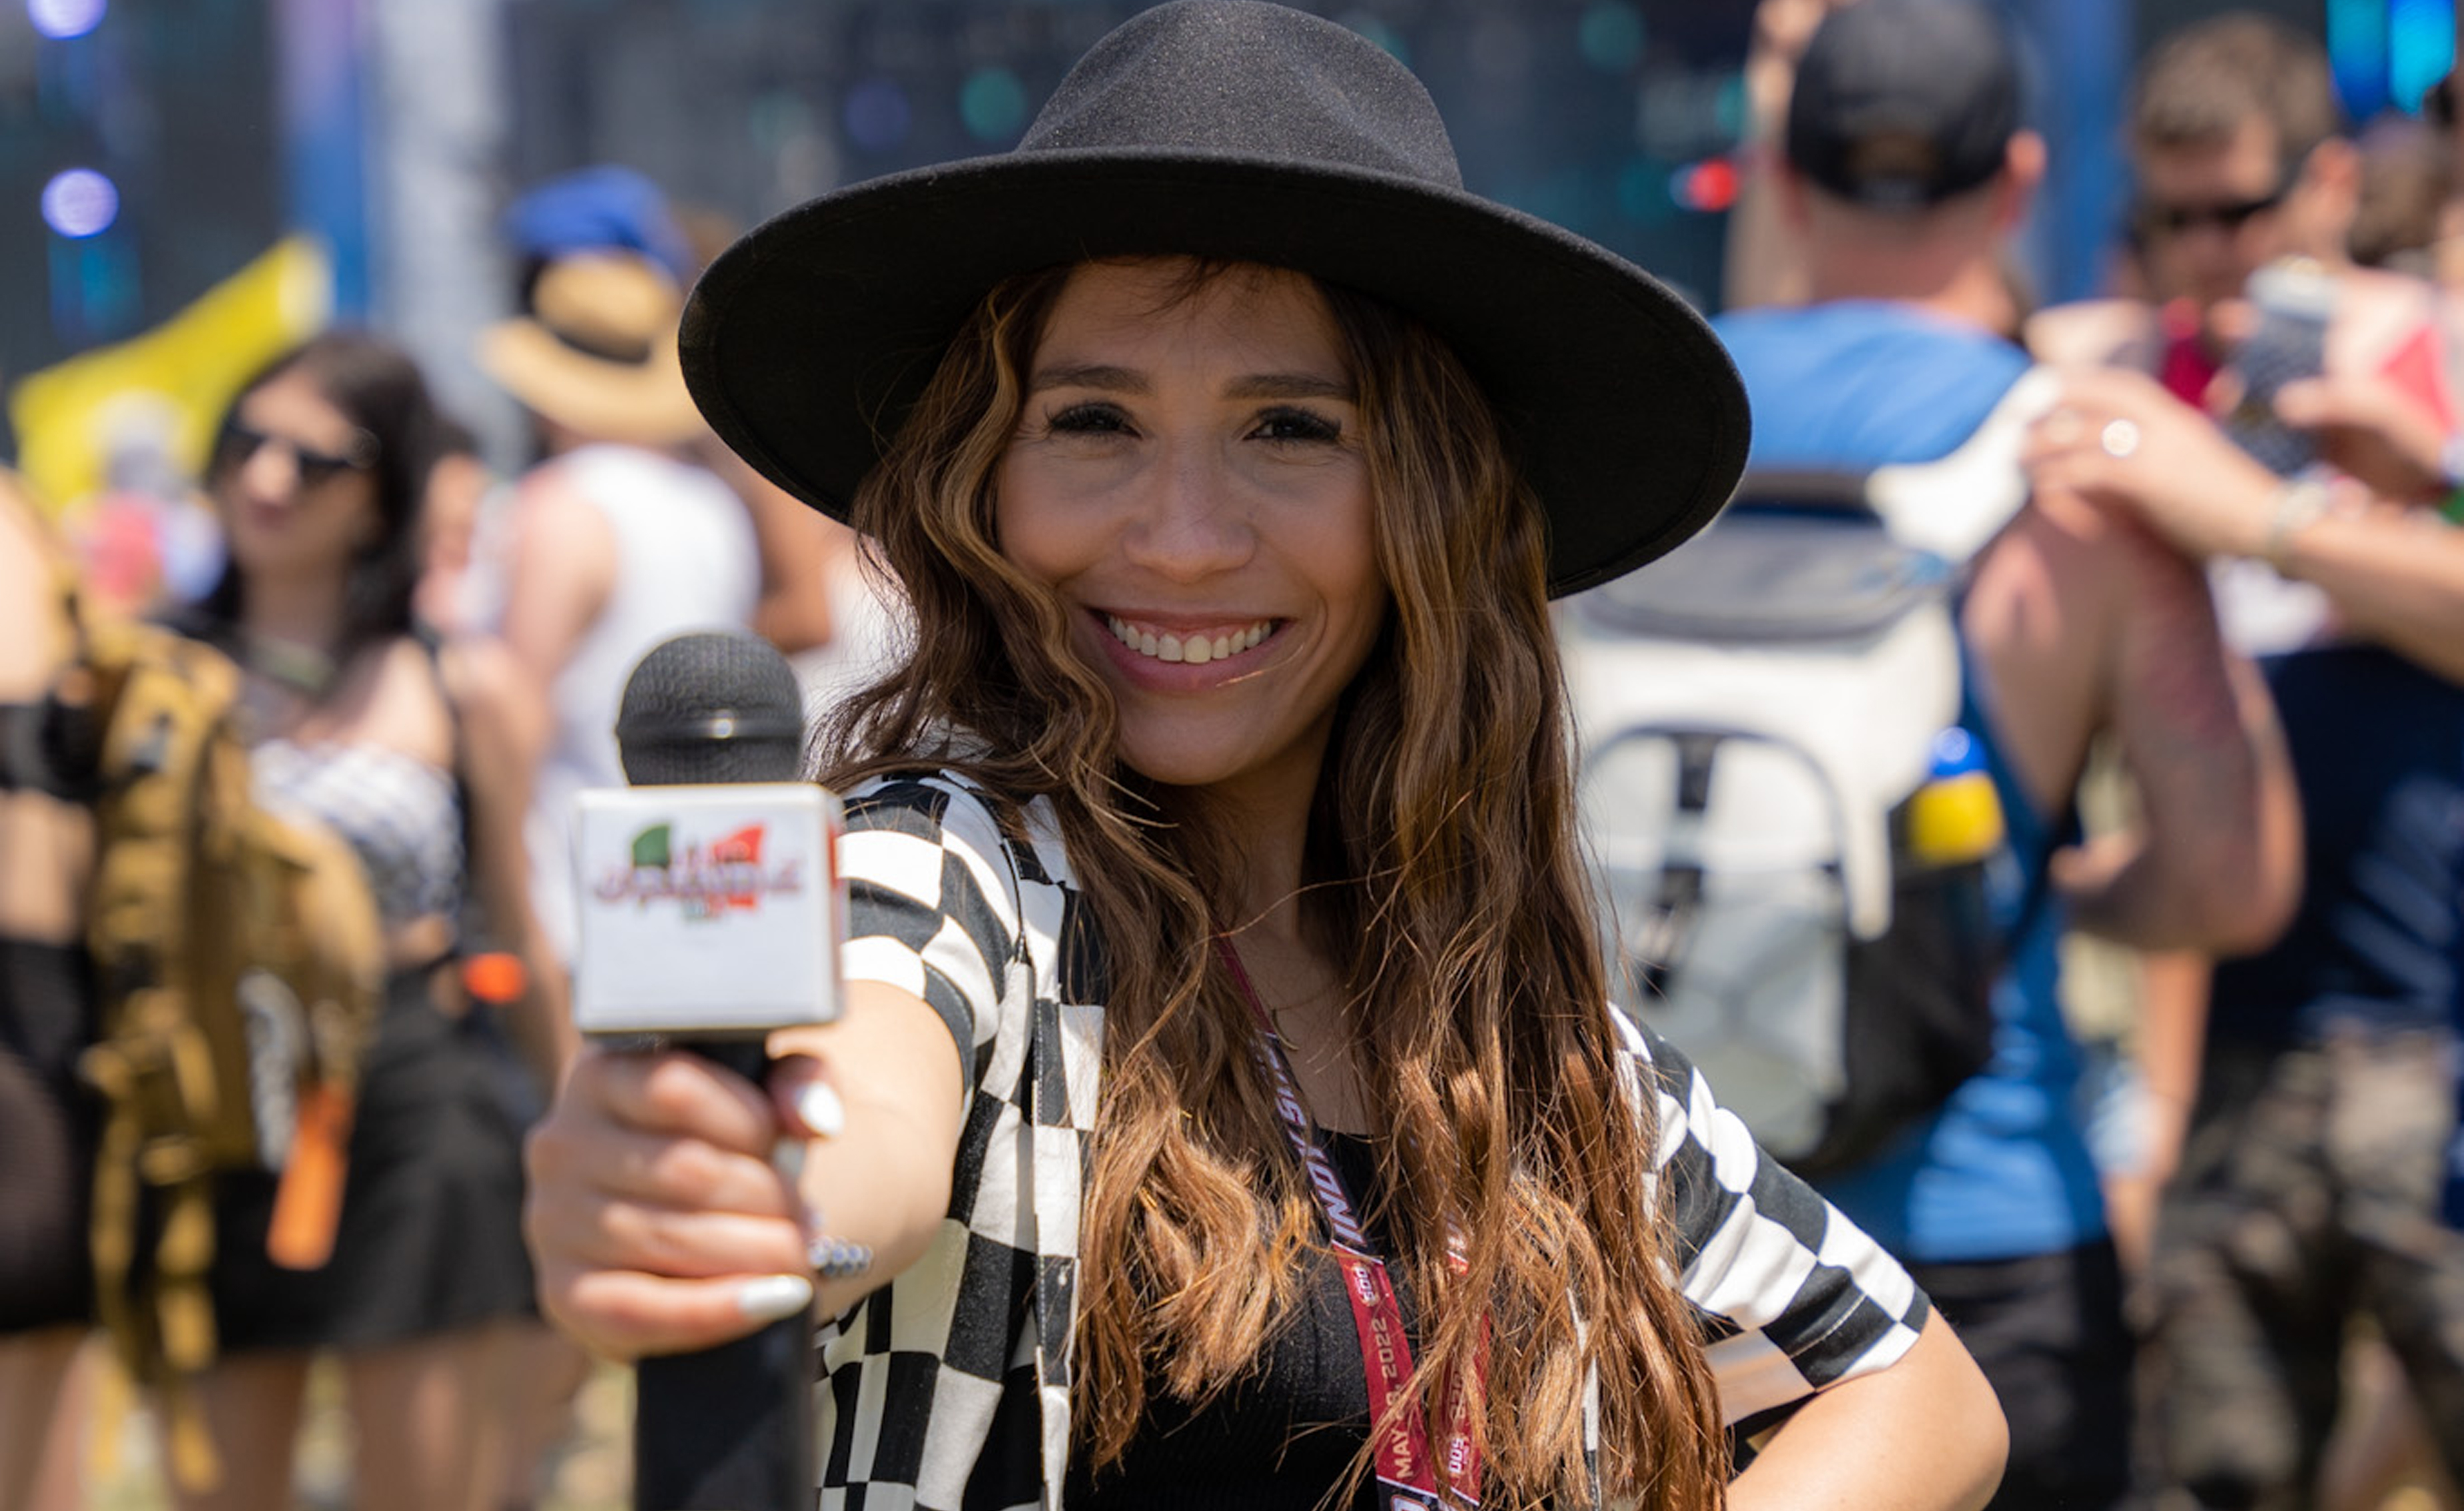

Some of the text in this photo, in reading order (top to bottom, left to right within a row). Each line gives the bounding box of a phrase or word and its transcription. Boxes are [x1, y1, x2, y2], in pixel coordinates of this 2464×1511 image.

[1287, 1129, 1366, 1246] INDY
[1371, 1316, 1398, 1381] 2022
[1390, 1428, 1414, 1479] MAY
[1448, 1437, 1464, 1474] 500
